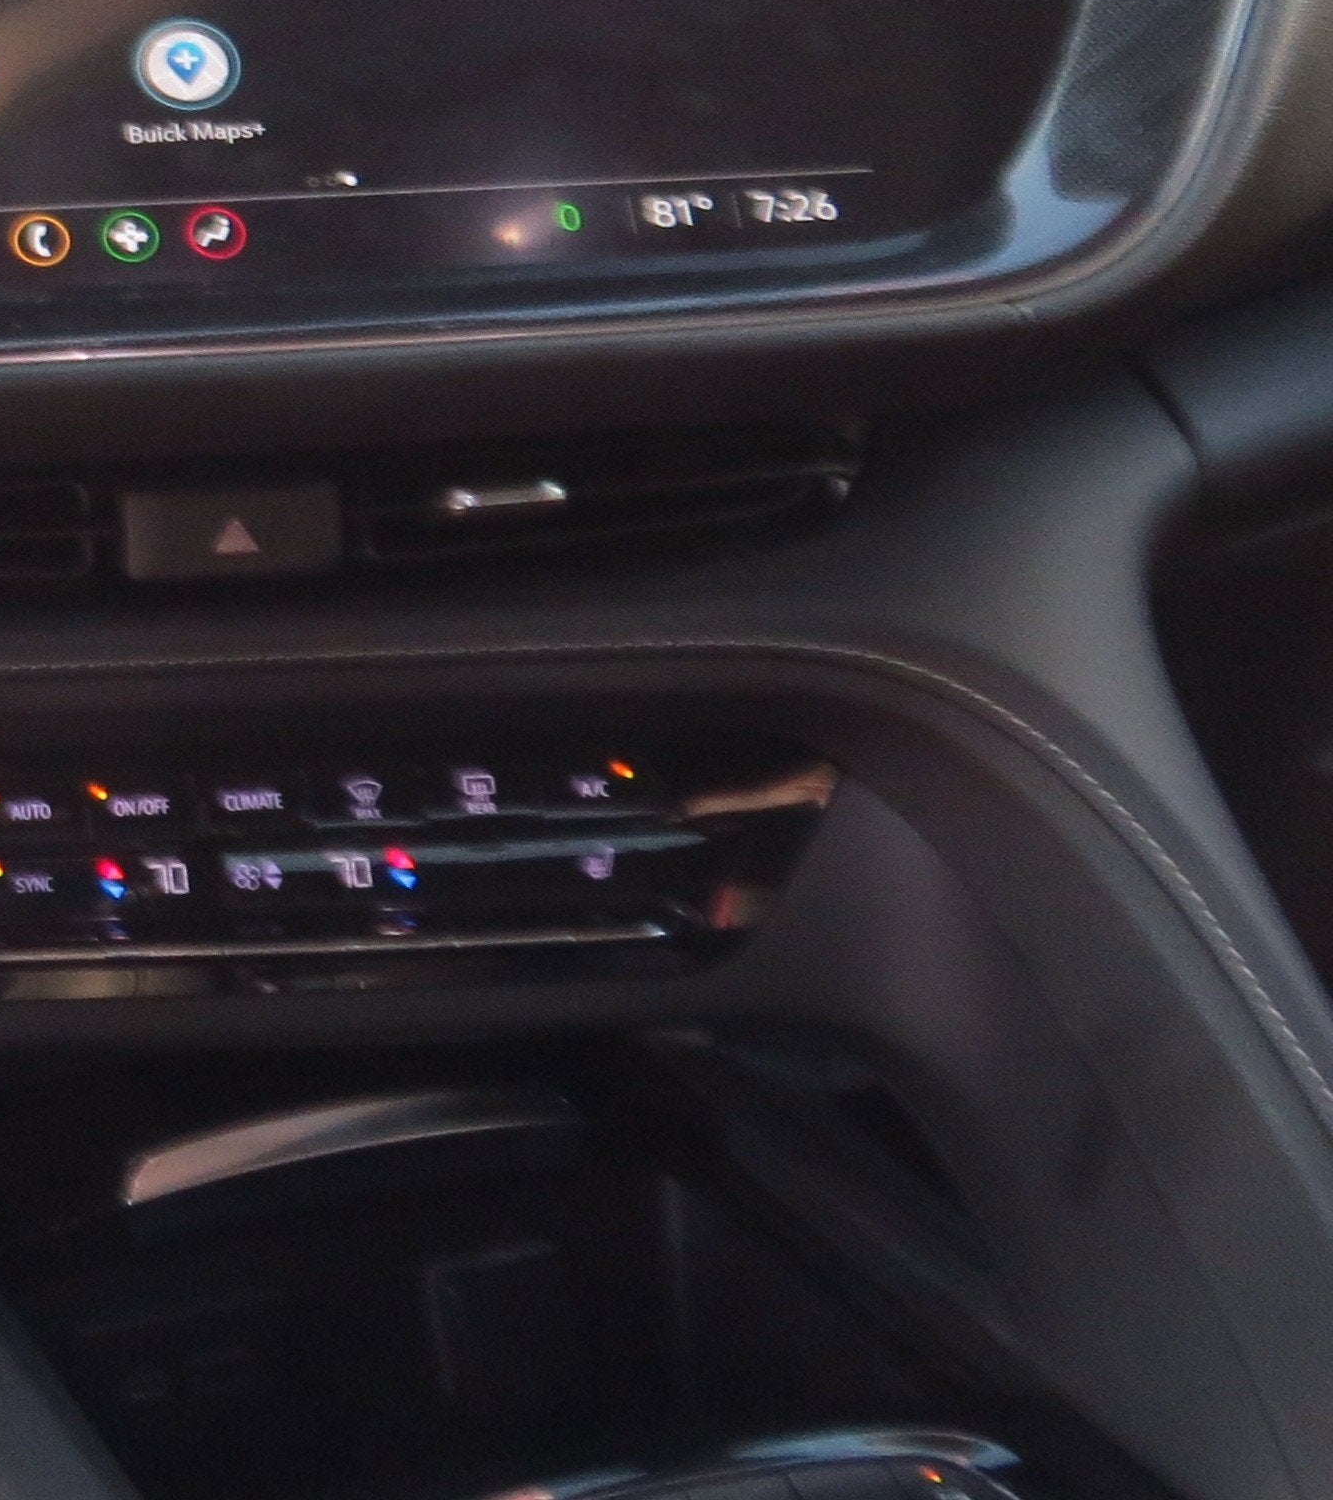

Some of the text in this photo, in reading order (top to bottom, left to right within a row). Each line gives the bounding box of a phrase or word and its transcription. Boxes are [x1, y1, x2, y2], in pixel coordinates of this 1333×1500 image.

[123, 120, 267, 146] Buick Maps+
[746, 189, 840, 223] 7:26
[4, 800, 52, 821] AUTO
[109, 796, 171, 818] ON/OFF
[218, 787, 285, 811] CLIMATE
[10, 873, 54, 895] SYNC
[145, 856, 190, 896] 70
[327, 855, 373, 889] 70
